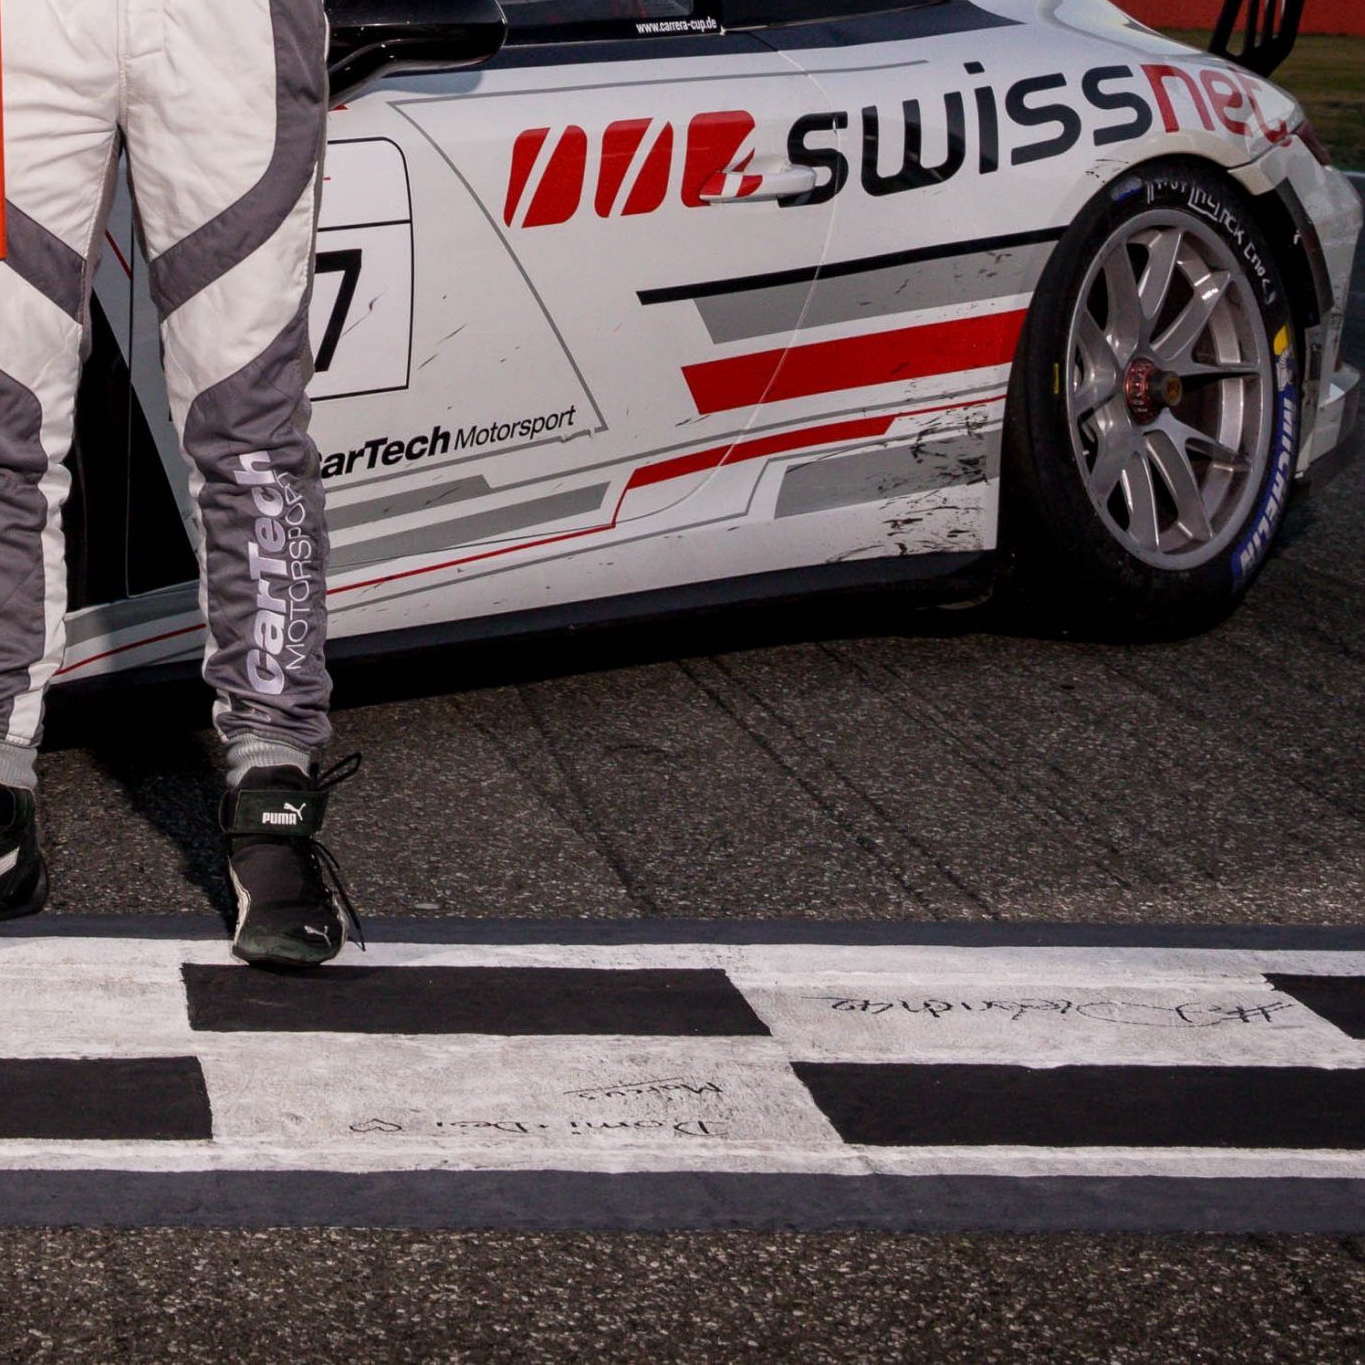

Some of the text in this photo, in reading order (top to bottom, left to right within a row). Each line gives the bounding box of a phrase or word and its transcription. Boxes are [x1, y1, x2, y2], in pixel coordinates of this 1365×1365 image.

[636, 17, 717, 34] www.carrera-cup.de
[777, 62, 1292, 207] swissnet
[320, 405, 576, 479] arTech Motorsport
[1239, 397, 1298, 570] MICHELIN
[234, 451, 286, 694] CarTech
[262, 811, 298, 825] PUMA
